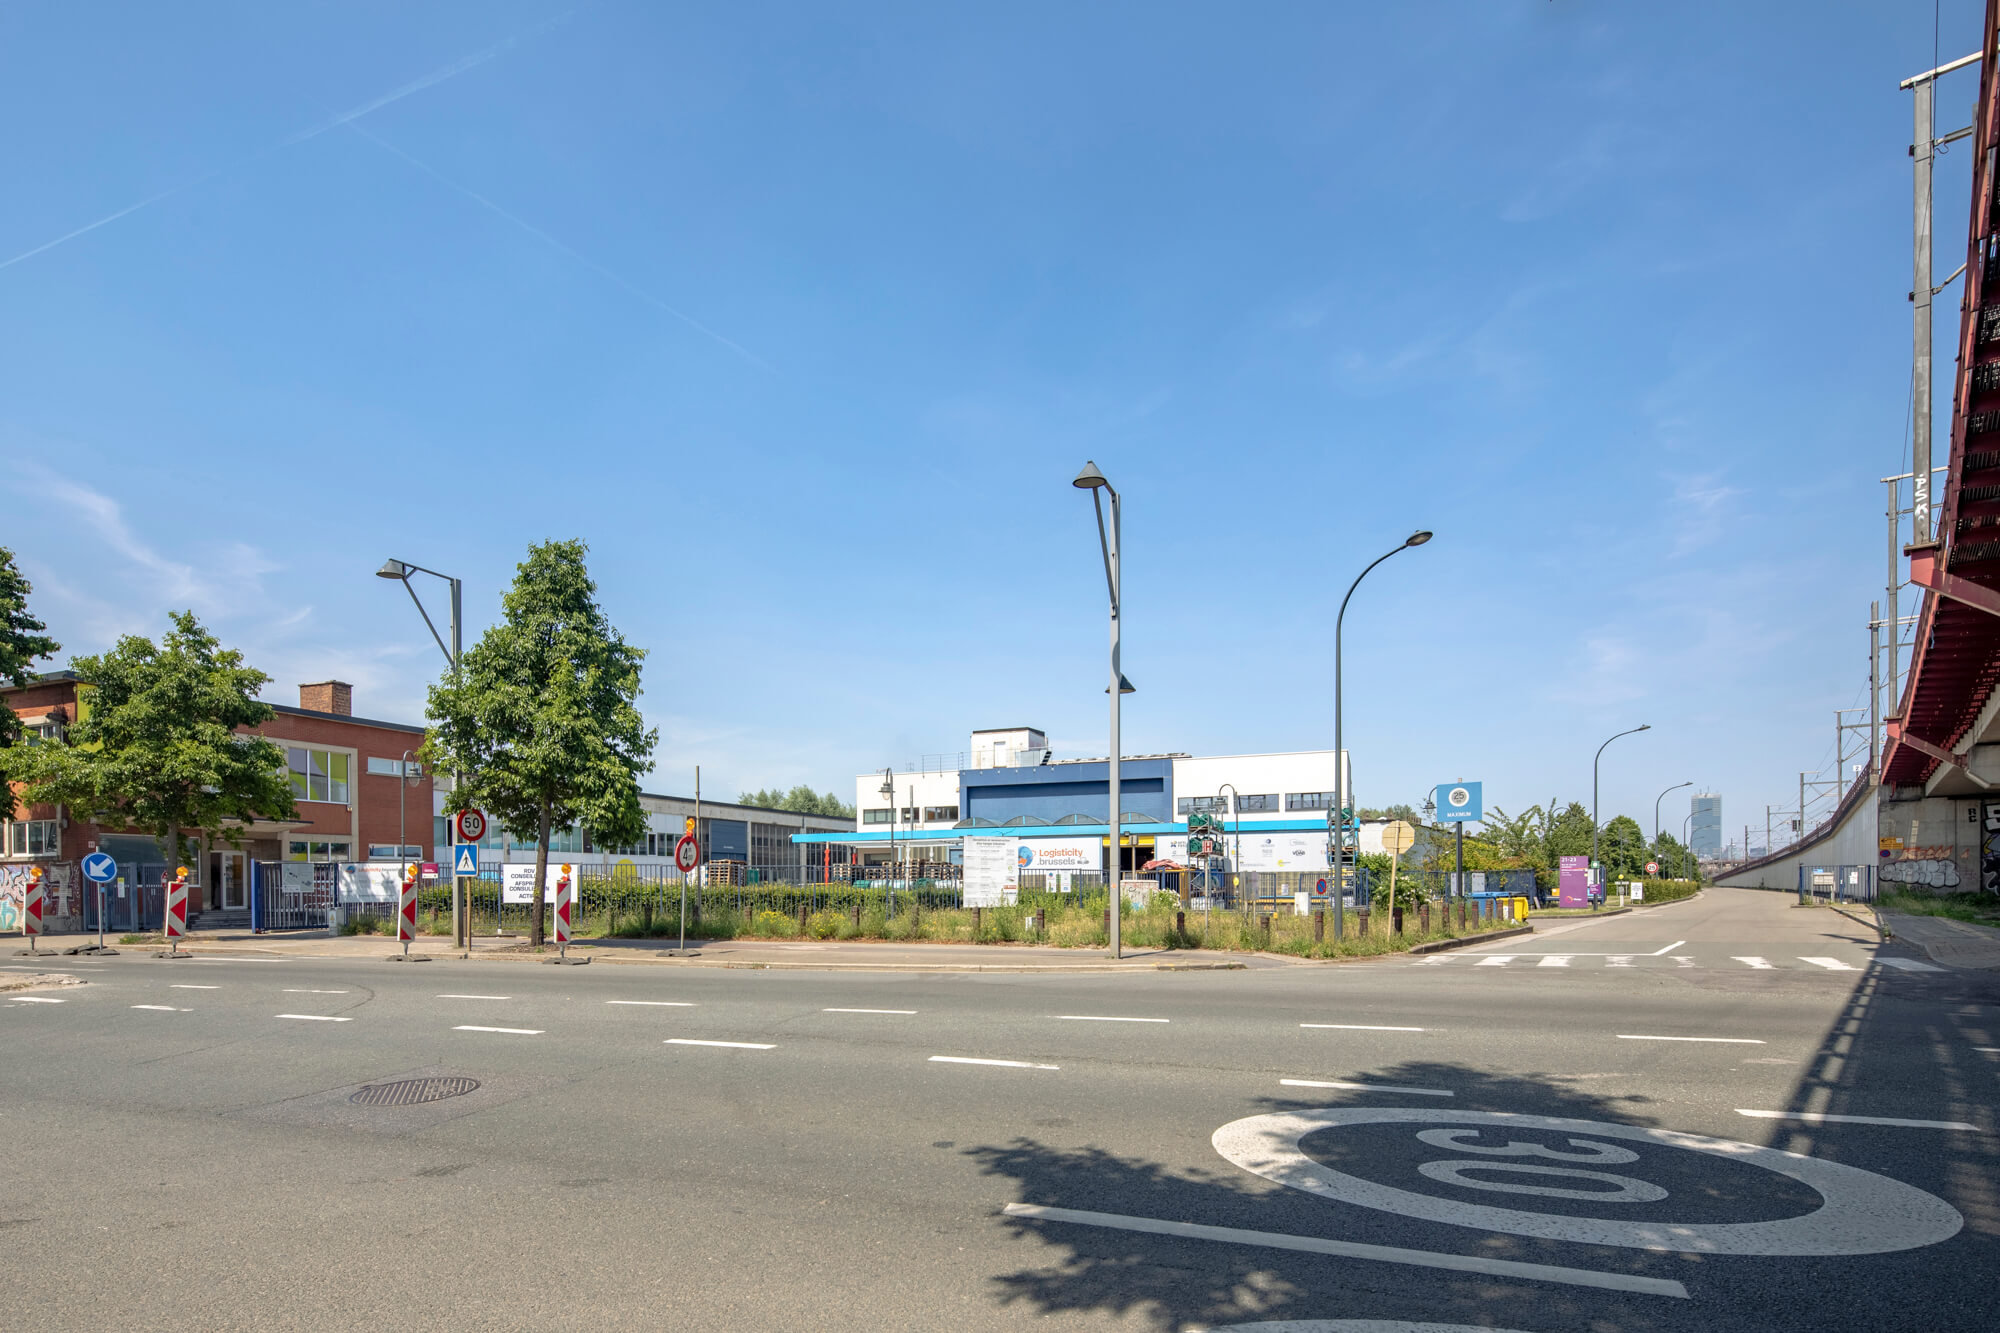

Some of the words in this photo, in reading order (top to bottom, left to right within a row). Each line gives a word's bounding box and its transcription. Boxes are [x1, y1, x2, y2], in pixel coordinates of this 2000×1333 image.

[1453, 791, 1465, 800] 25
[464, 817, 480, 829] 50
[1205, 843, 1211, 852] H
[682, 848, 688, 861] 4
[1039, 848, 1084, 859] Logisticity
[1037, 857, 1076, 866] .brussels
[1415, 1128, 1670, 1203] 30
